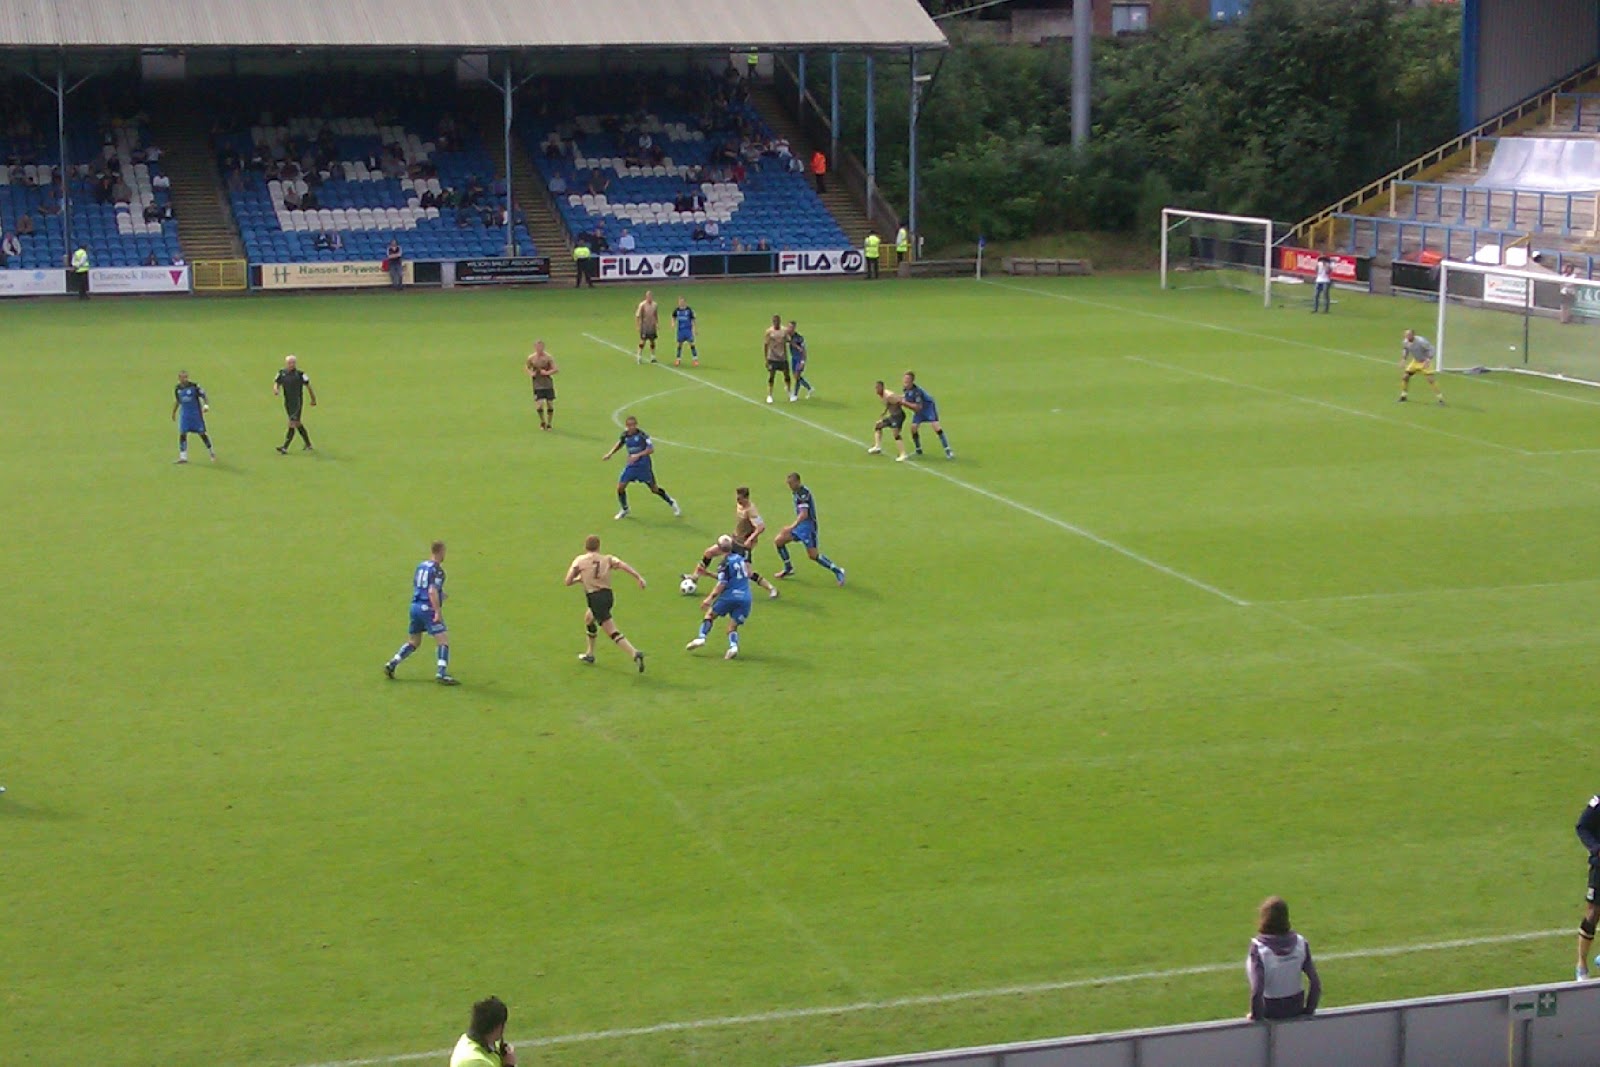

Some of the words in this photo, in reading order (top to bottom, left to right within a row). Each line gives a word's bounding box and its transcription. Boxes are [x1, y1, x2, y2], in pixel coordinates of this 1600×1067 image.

[299, 265, 338, 275] Hanson
[602, 257, 653, 275] FILA
[664, 257, 685, 273] JD
[782, 254, 831, 271] FILA
